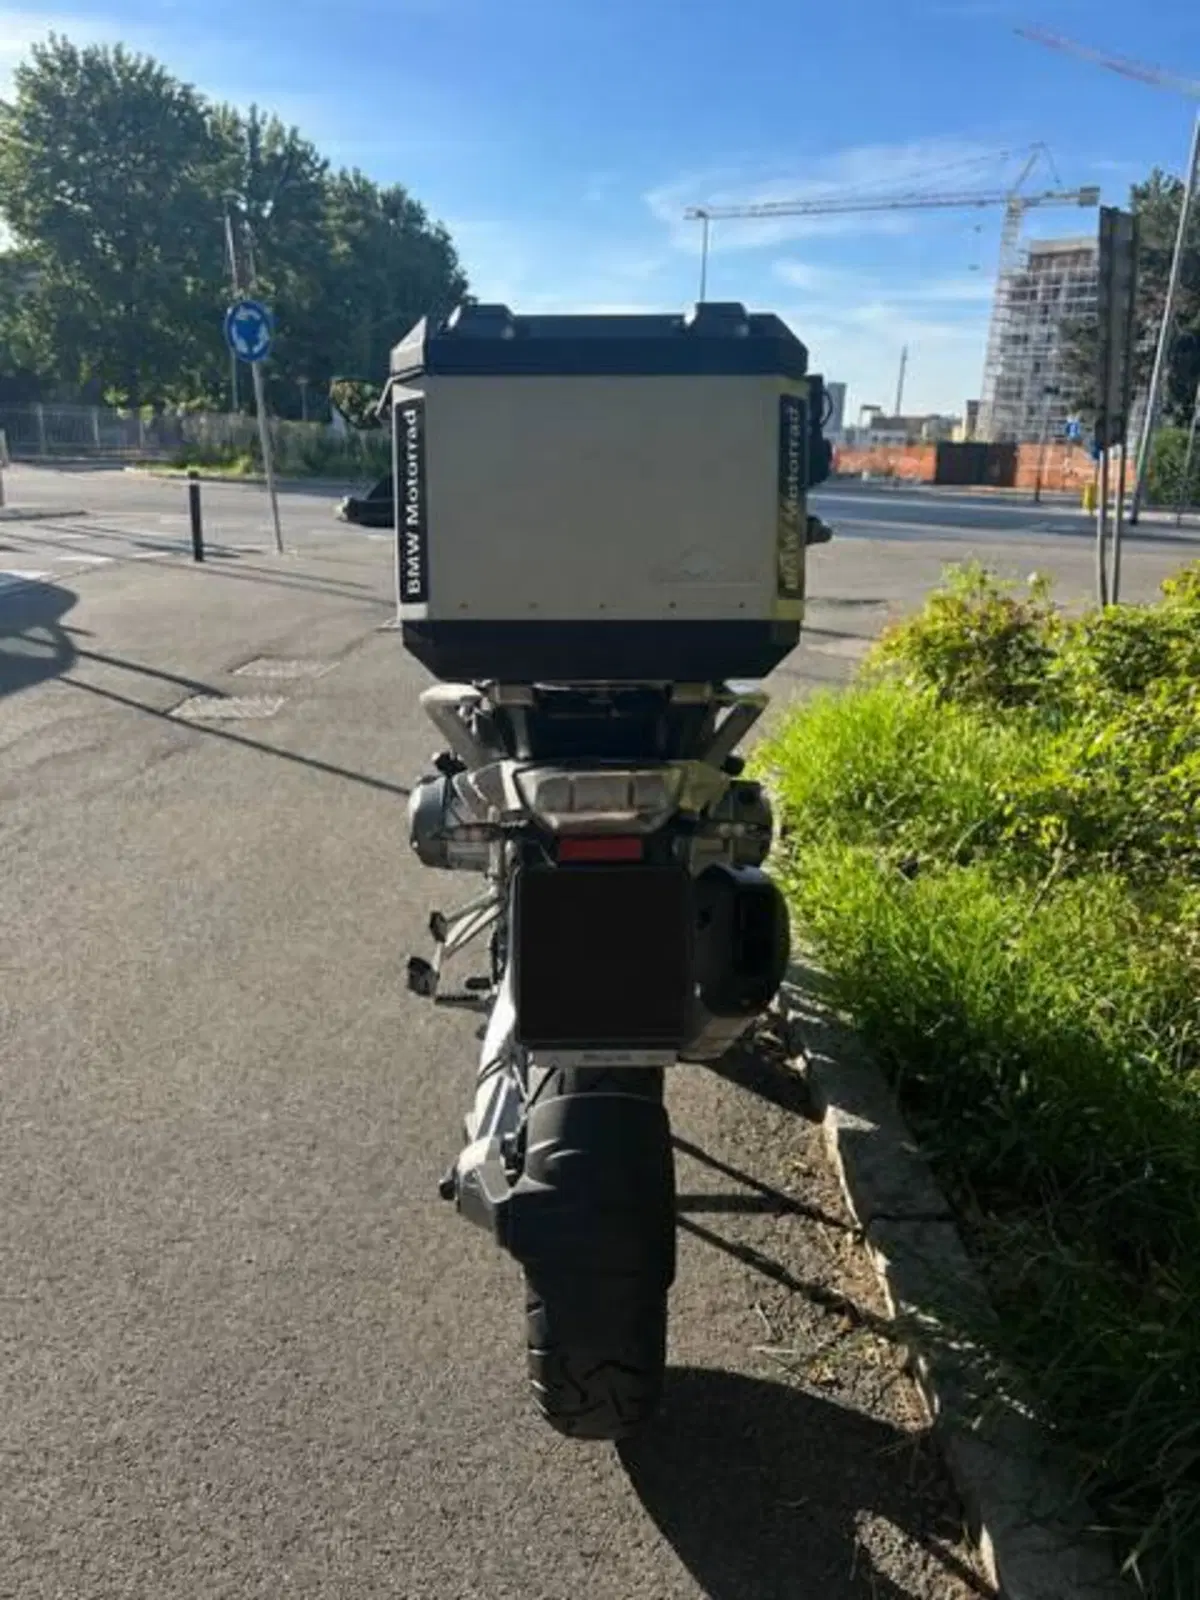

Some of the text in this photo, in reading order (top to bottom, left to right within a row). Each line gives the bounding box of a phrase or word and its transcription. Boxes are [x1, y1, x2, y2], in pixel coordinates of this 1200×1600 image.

[403, 408, 421, 595] BMW Motorrad
[784, 405, 801, 523] Motorrad
